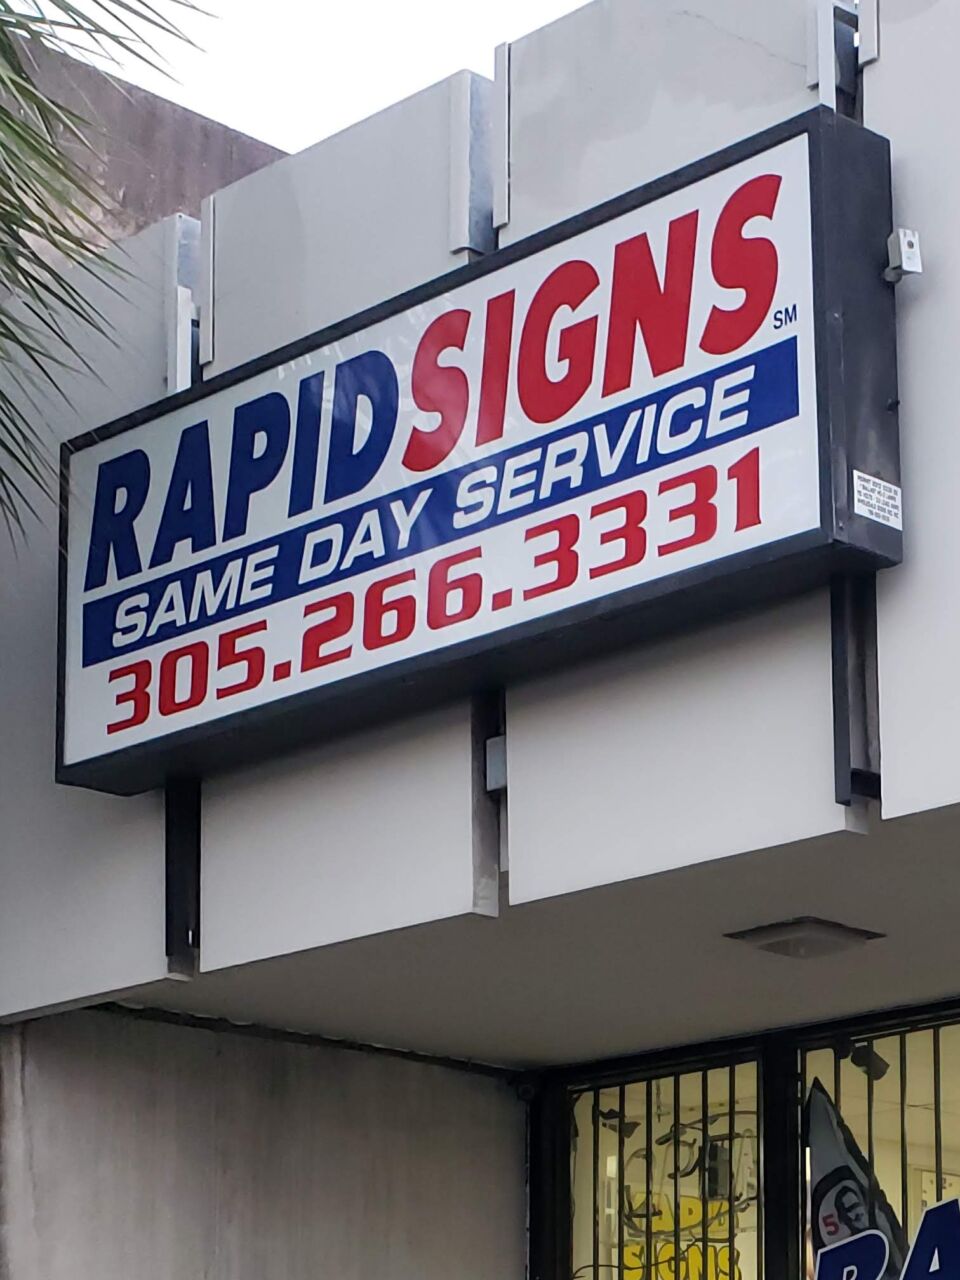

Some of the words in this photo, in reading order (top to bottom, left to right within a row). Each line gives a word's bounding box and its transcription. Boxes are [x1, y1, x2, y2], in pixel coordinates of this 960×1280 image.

[773, 304, 798, 331] SM
[106, 447, 763, 735] 305.266.3331
[112, 551, 274, 649] SAME
[297, 490, 430, 577] DAY
[451, 364, 756, 529] SERVICE
